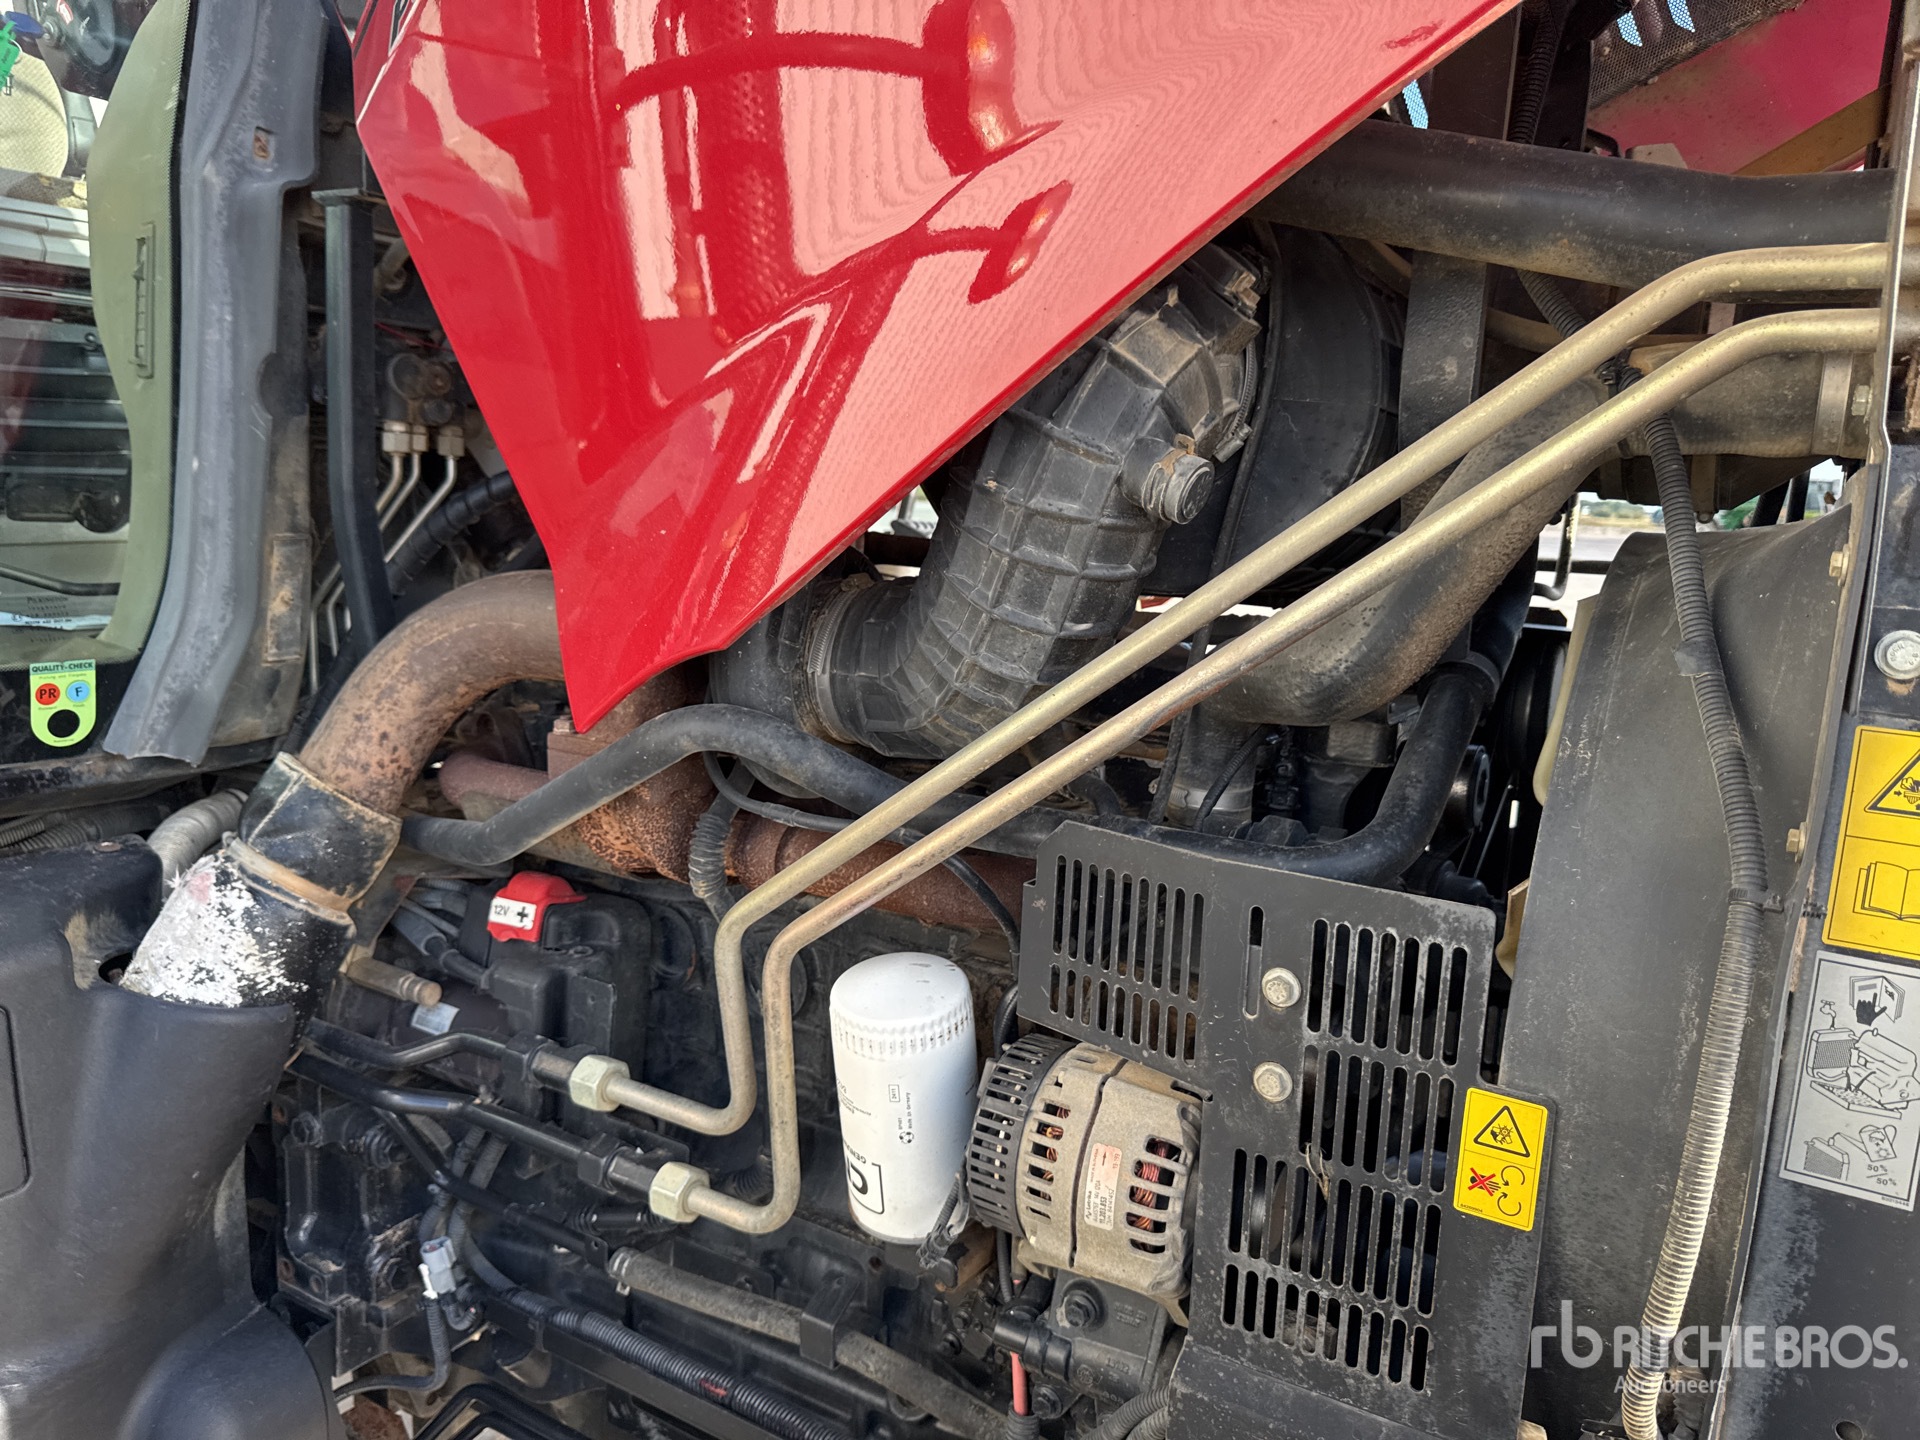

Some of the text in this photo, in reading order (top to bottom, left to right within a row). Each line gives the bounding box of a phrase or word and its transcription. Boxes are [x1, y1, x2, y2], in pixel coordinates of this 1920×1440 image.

[31, 661, 94, 673] QUALITY-CHECK
[39, 687, 57, 700] PR
[75, 686, 83, 698] F
[494, 904, 510, 917] 12V
[1867, 1164, 1888, 1172] 50%
[1876, 1177, 1897, 1186] 50%
